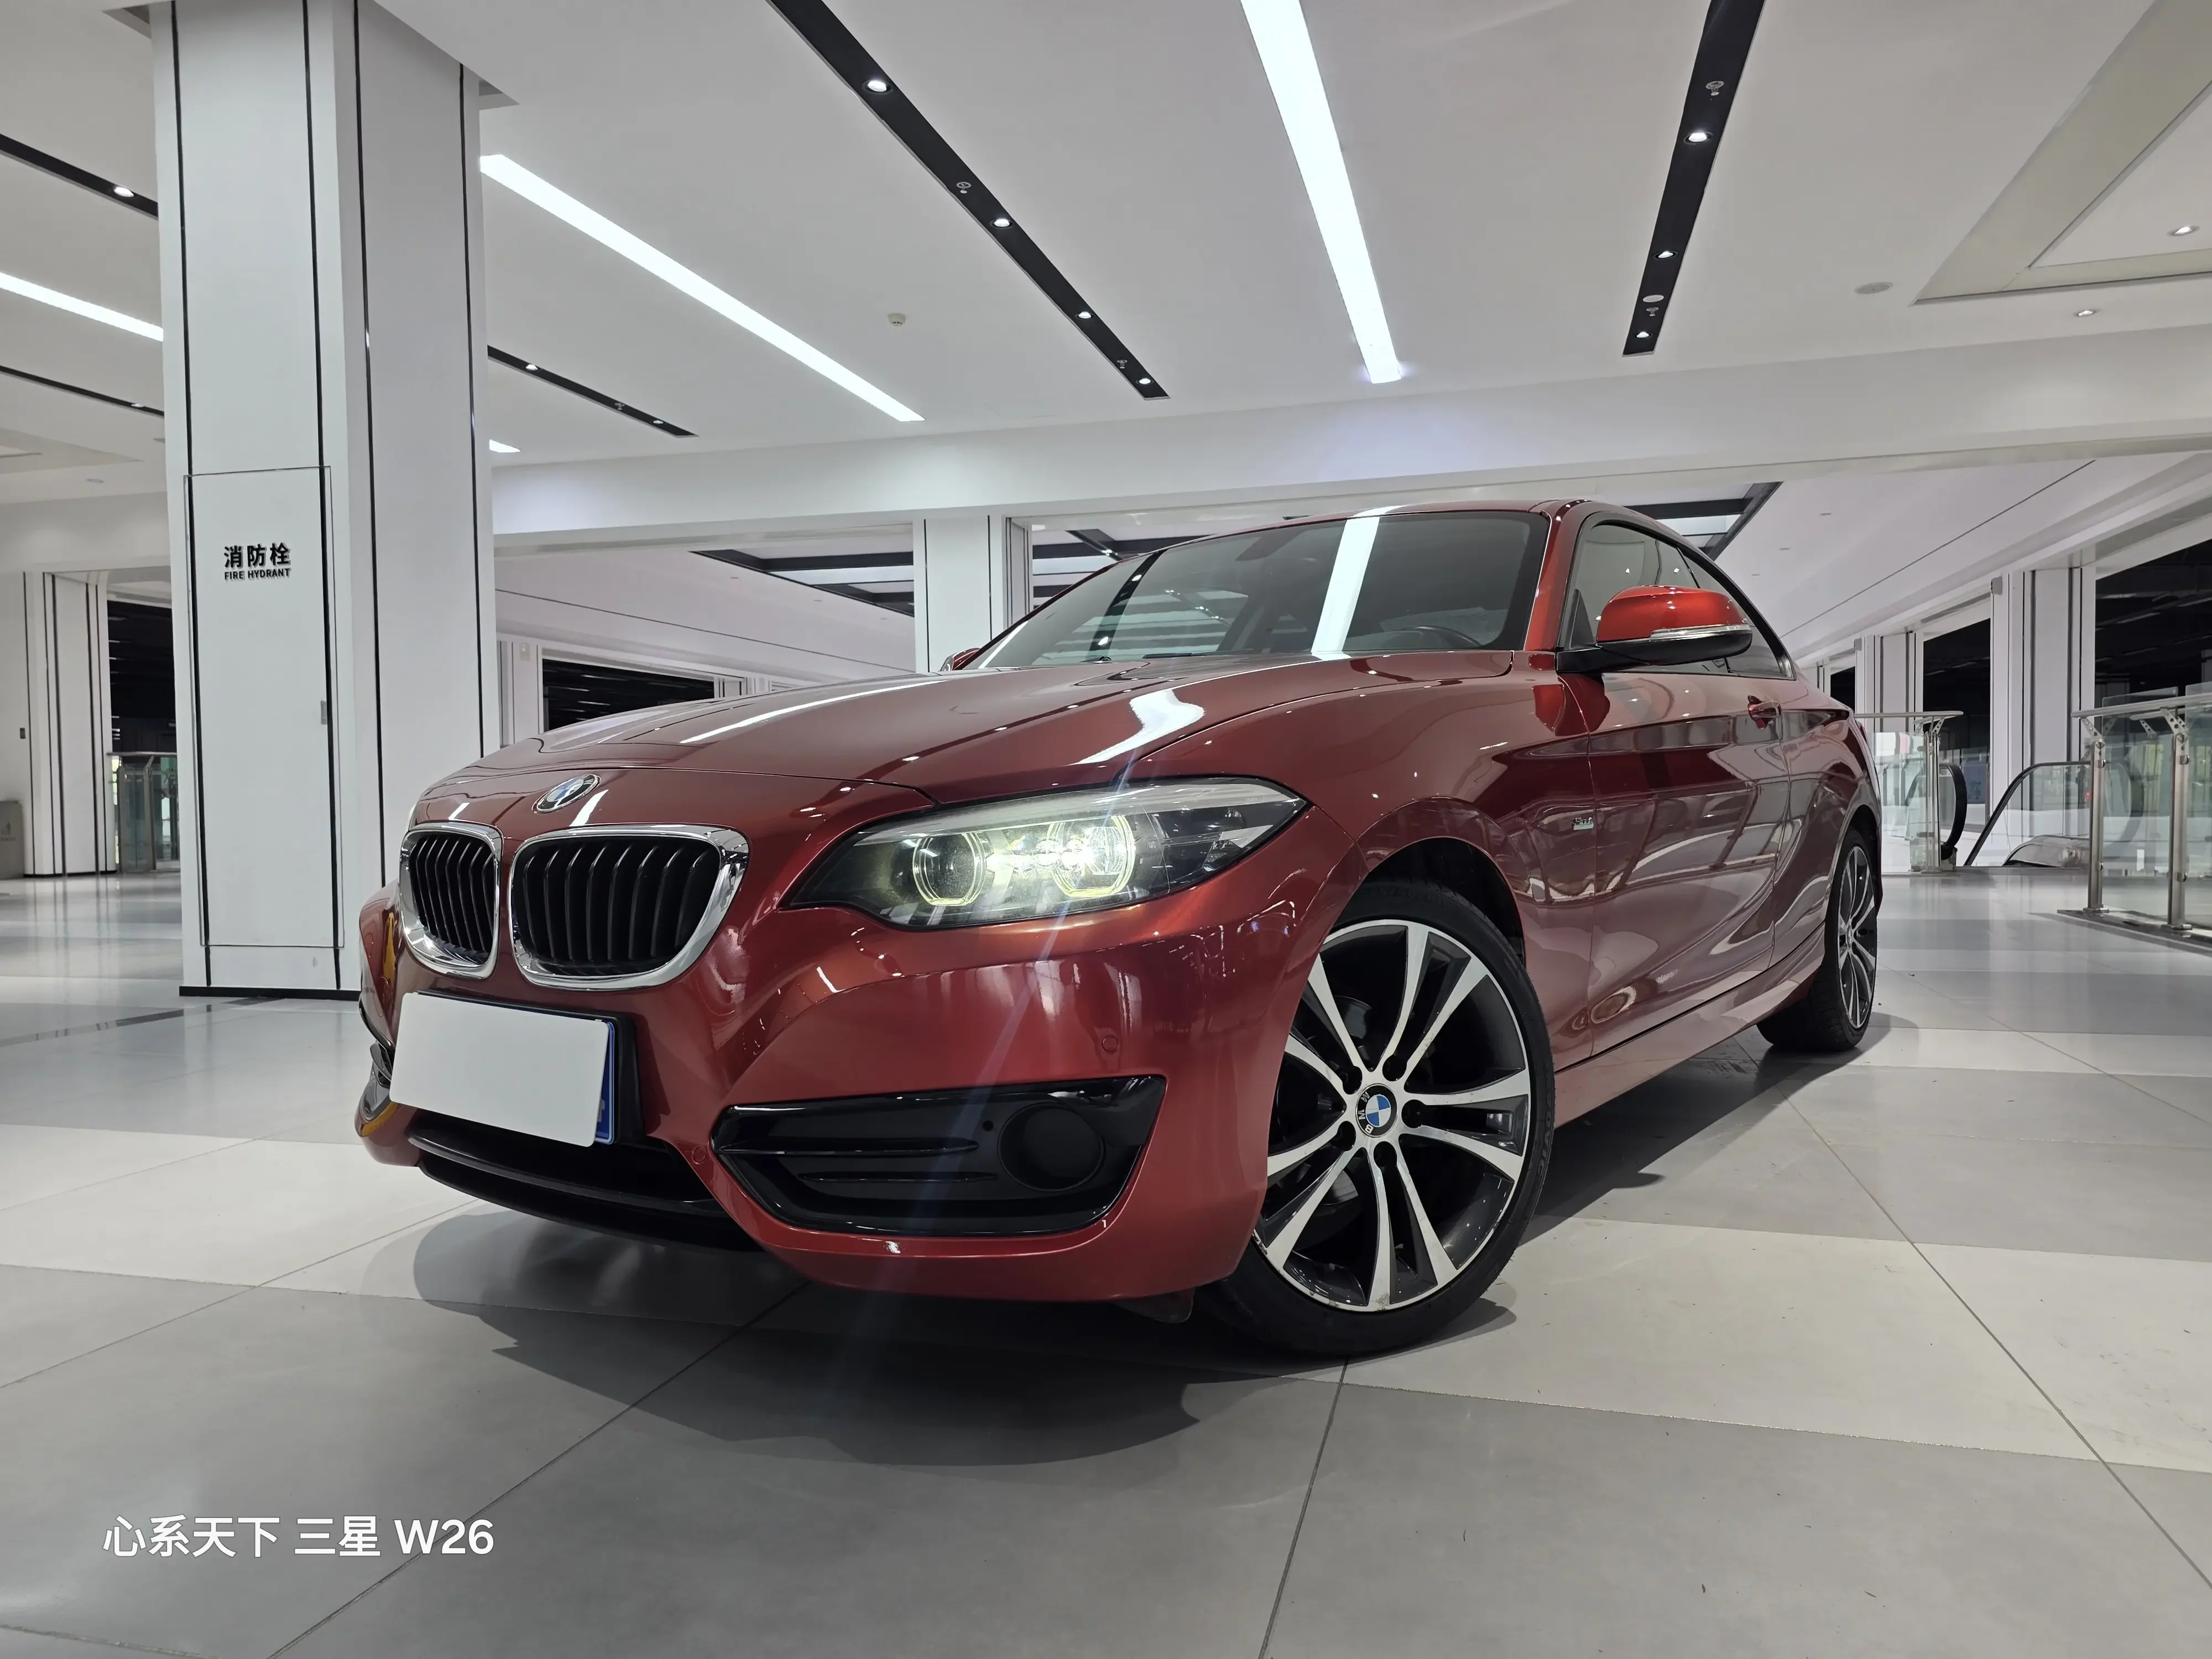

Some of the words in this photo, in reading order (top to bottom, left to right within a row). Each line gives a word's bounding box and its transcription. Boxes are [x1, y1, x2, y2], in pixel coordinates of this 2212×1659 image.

[223, 542, 290, 568] 消防栓
[225, 571, 244, 580] FIRE
[248, 568, 290, 579] HYDRANT
